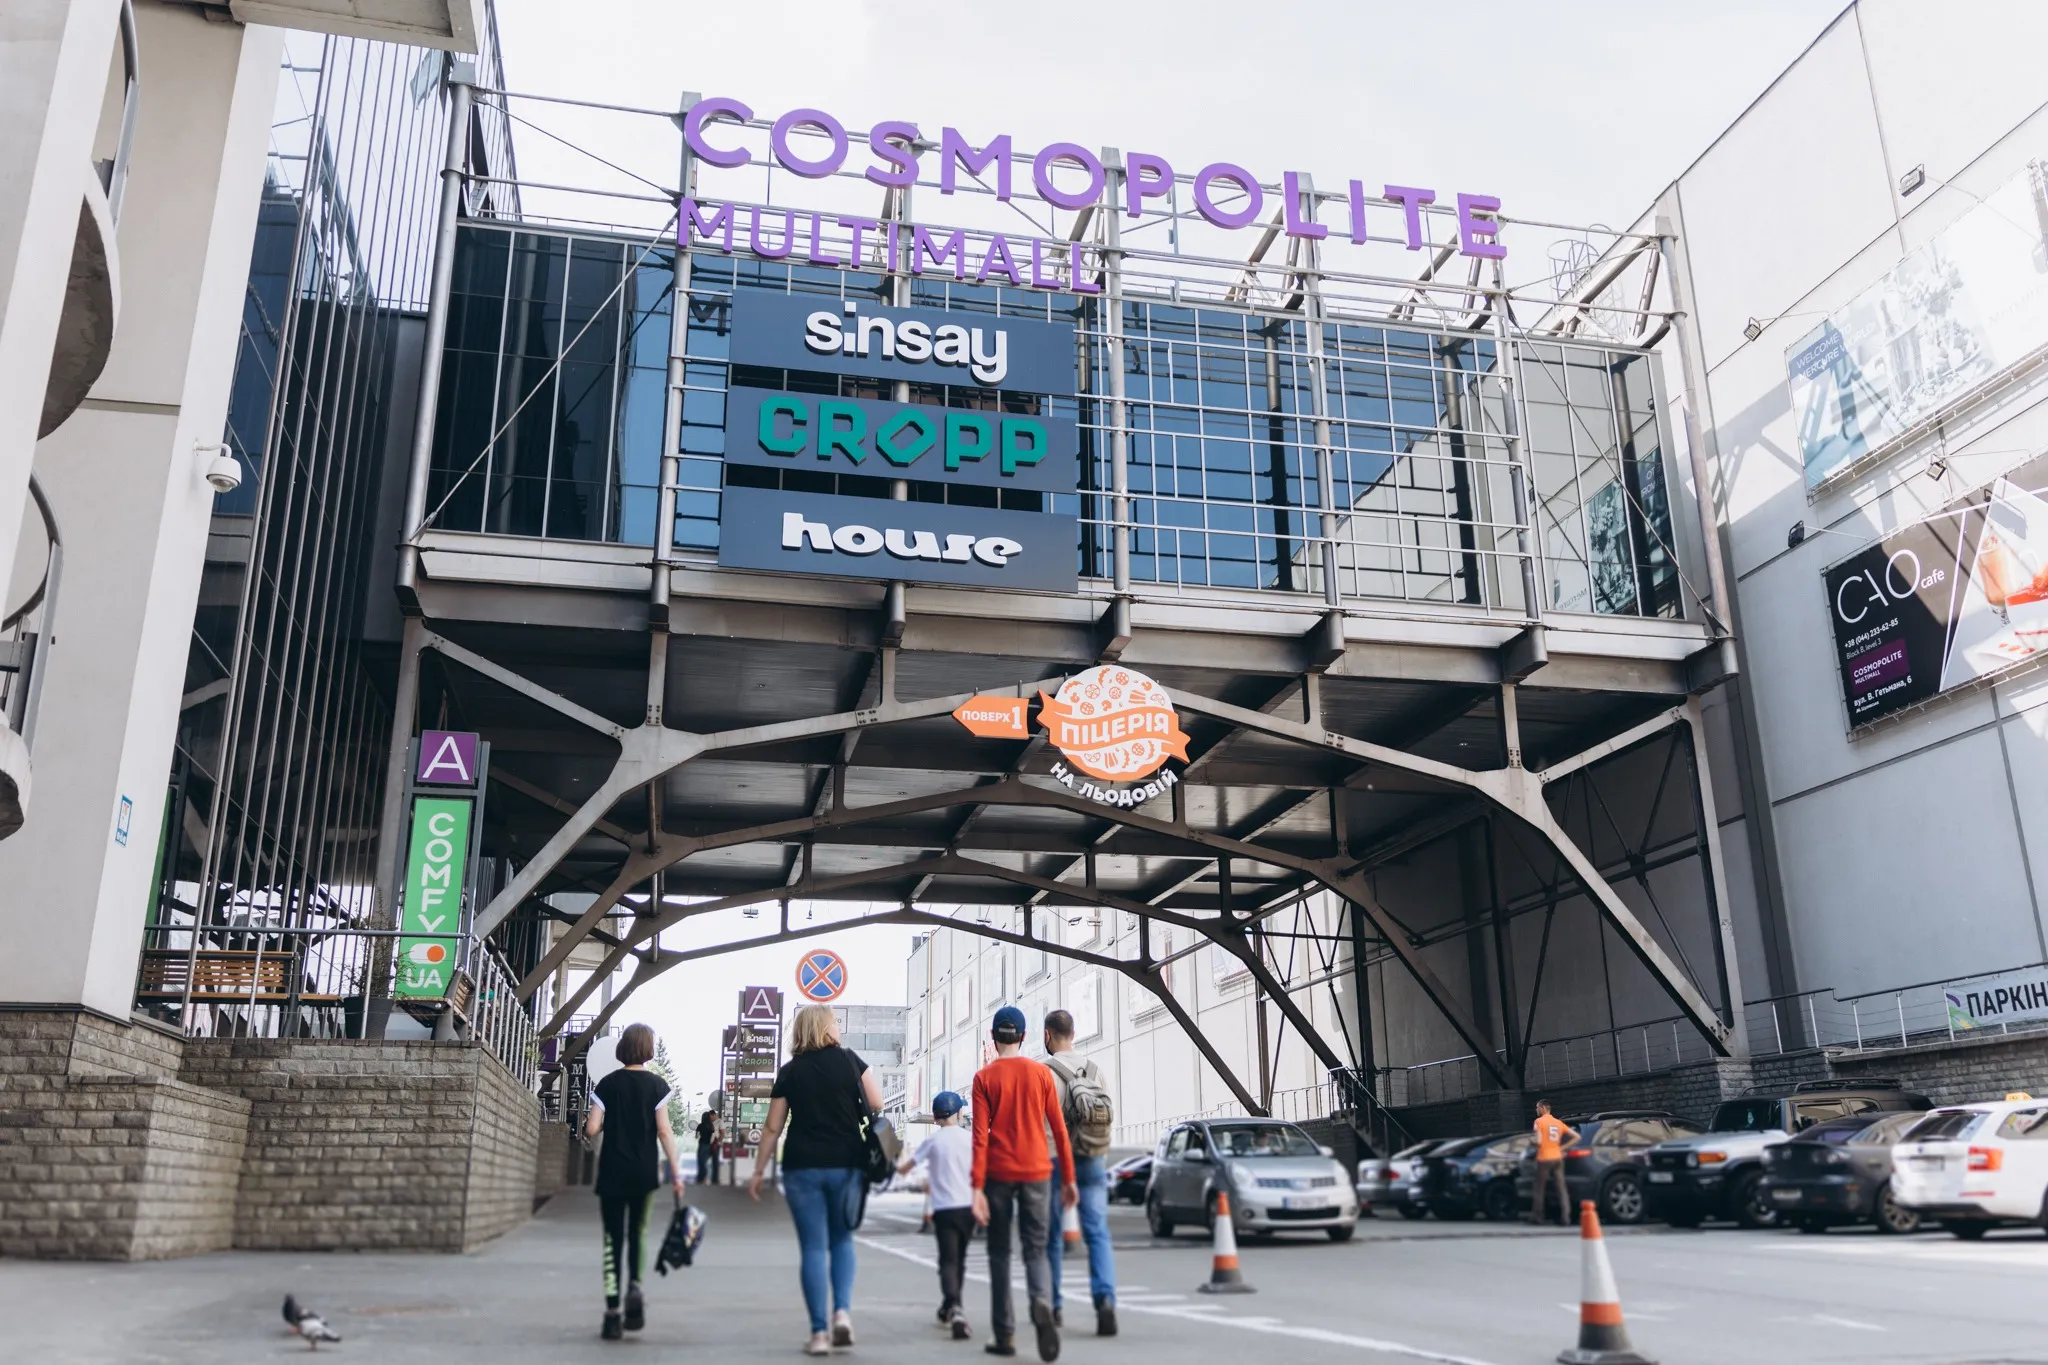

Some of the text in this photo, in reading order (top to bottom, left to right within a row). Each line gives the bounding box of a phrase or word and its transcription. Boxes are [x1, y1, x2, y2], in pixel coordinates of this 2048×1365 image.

[683, 96, 1508, 261] COSMOPOLITE
[677, 198, 1105, 295] MULTIMALL
[804, 301, 1008, 385] sinsay
[1796, 332, 1839, 369] WELCOME
[757, 394, 1050, 477] CROPP
[781, 511, 1023, 568] house
[1920, 569, 1945, 589] cafe
[1855, 632, 1870, 645] (044)
[1869, 617, 1899, 637] 233-62-85
[1865, 640, 1877, 651] level
[1853, 650, 1903, 678] COSMOPOLITE
[1855, 669, 1881, 685] MULTIMALL
[1875, 679, 1907, 698] Гетьмана,
[1906, 675, 1913, 684] 6
[962, 706, 1023, 730] ПОВЕРХ 1
[1061, 712, 1169, 745] ПІЦЕРІЯ
[422, 735, 469, 781] A
[1050, 761, 1179, 808] НА ЛЬОДОВІЙ
[417, 812, 455, 933] COMFY
[405, 968, 443, 989] UA
[747, 988, 774, 1016] A
[1966, 981, 2048, 1018] ПАРКІН
[746, 1033, 774, 1045] sinsay
[1549, 1126, 1560, 1142] 5
